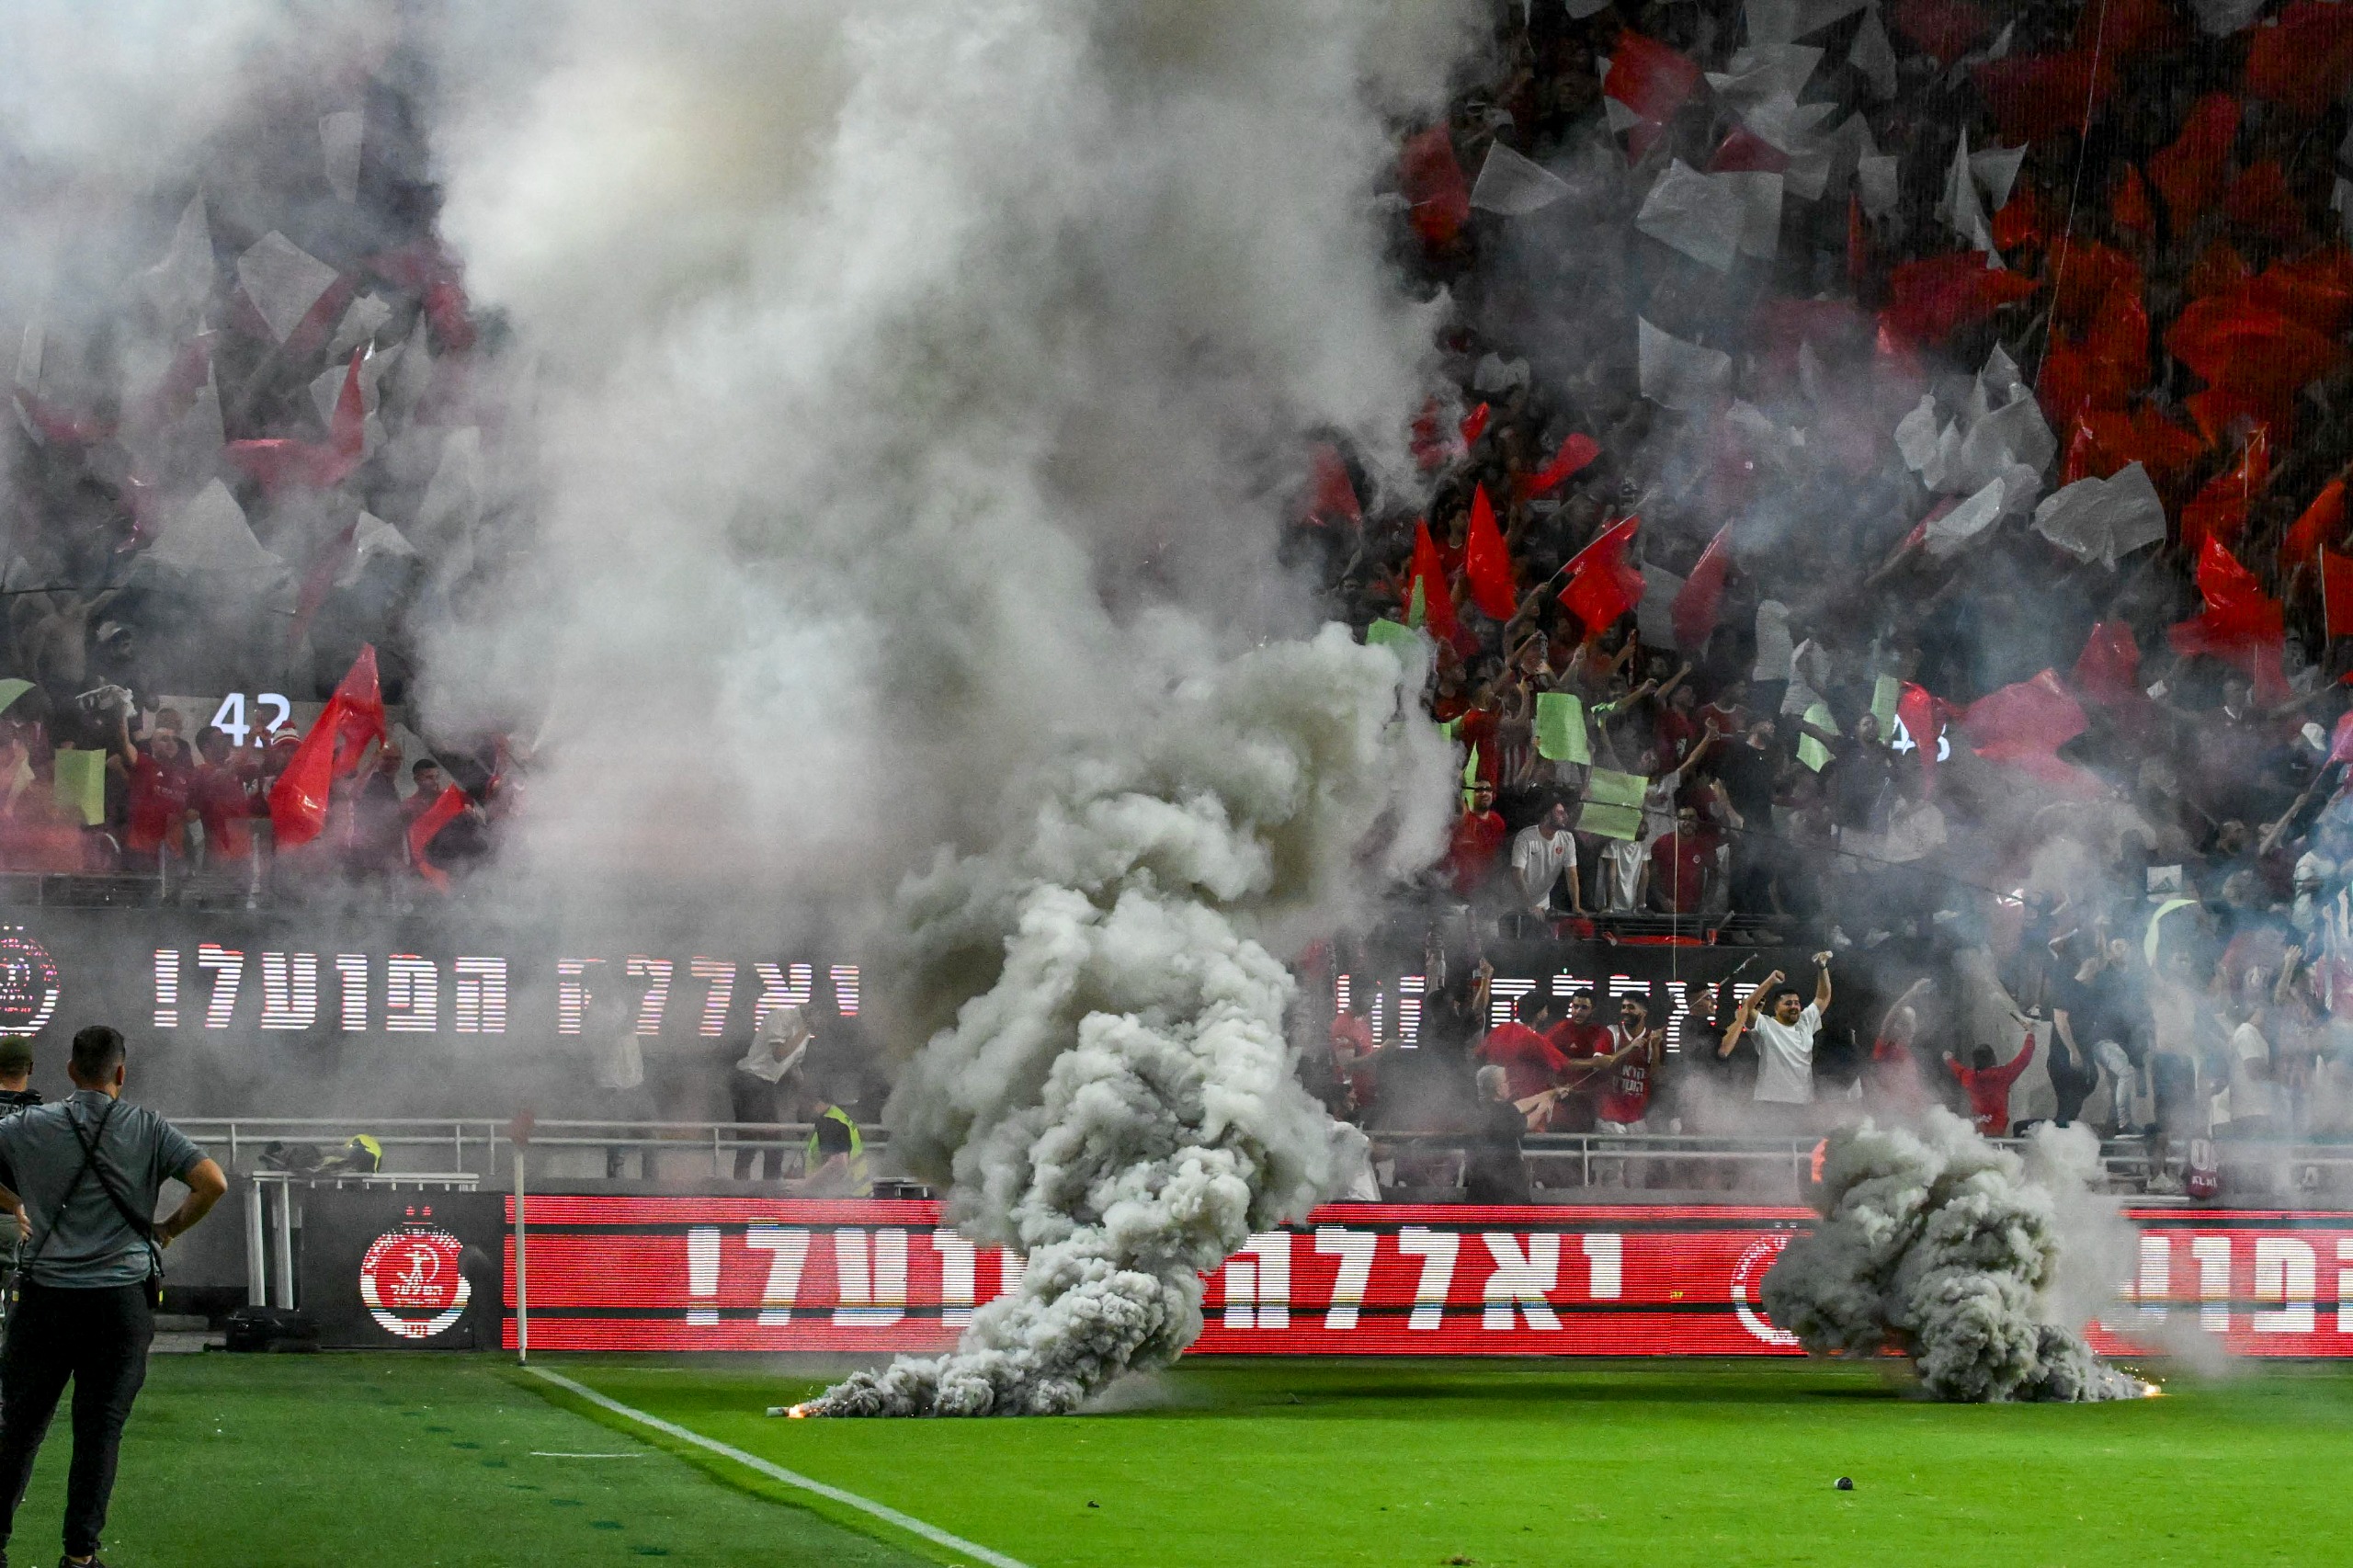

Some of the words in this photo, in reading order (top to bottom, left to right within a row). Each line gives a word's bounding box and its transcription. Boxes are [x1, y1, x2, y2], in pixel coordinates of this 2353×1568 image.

[210, 692, 290, 748] 42
[153, 944, 507, 1033] הפועל!
[686, 1217, 1029, 1327] ועל!
[1222, 1225, 1622, 1330] יאללה
